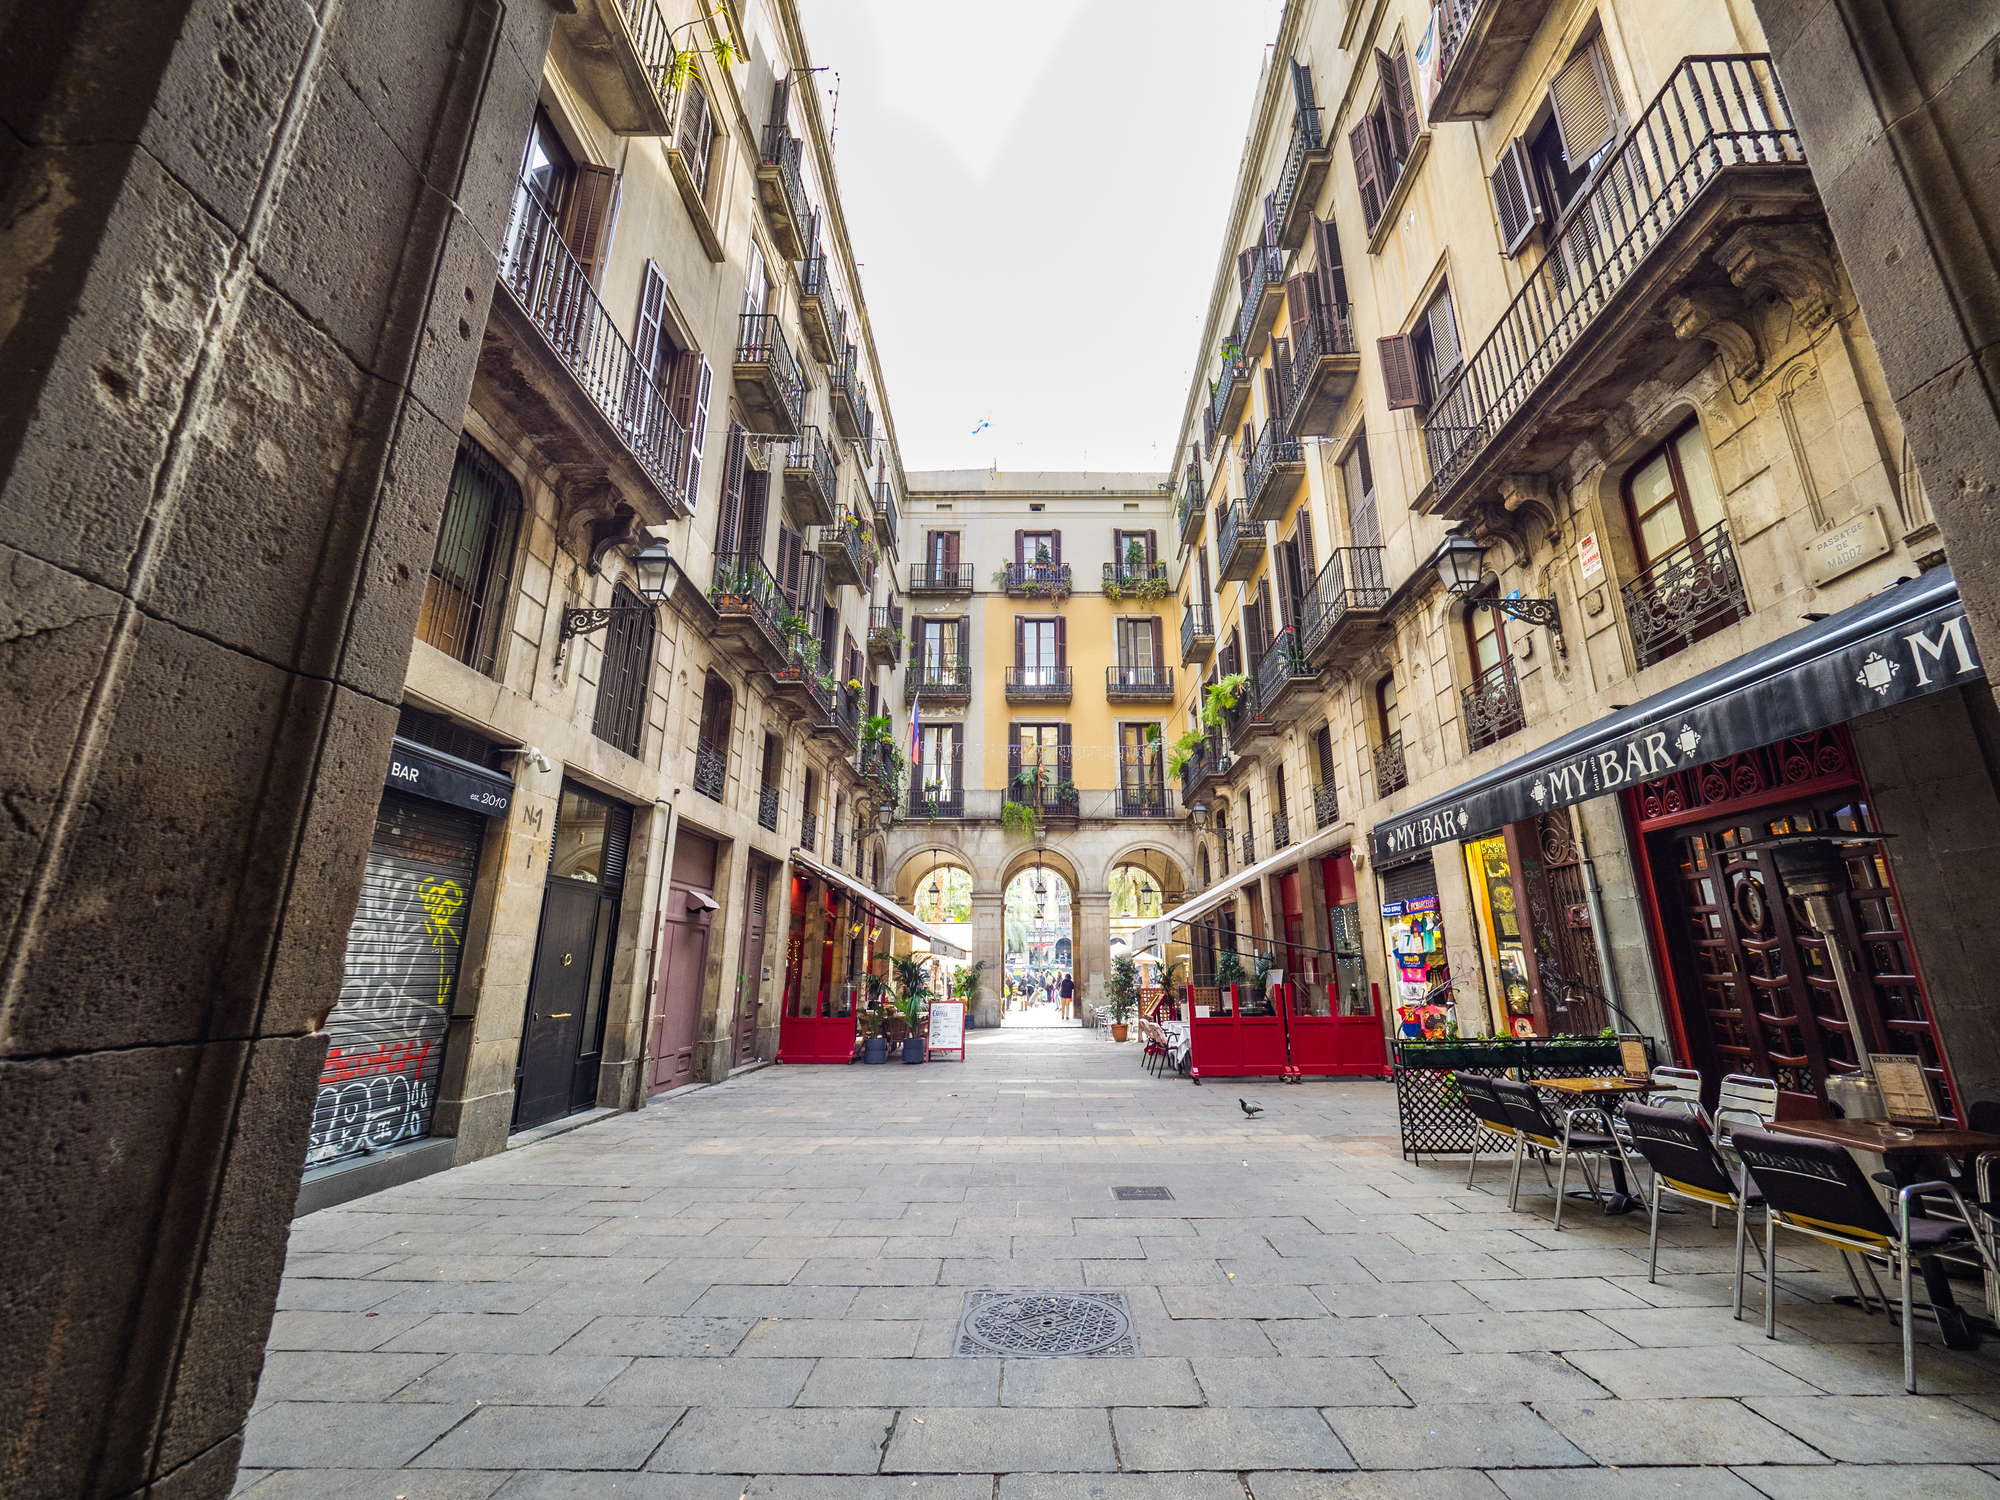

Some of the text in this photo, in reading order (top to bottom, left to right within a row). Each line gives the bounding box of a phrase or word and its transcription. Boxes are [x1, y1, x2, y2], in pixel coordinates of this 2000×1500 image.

[1817, 521, 1864, 551] PASSATGE
[1836, 540, 1849, 552] DE
[1827, 544, 1864, 570] MADOZ
[390, 761, 420, 784] BAR
[1548, 731, 1676, 805] MY BAR
[480, 792, 508, 810] 2010
[1396, 822, 1417, 852] MY
[1420, 810, 1458, 844] BAR
[1481, 847, 1507, 856] PARK
[1404, 934, 1411, 947] 7
